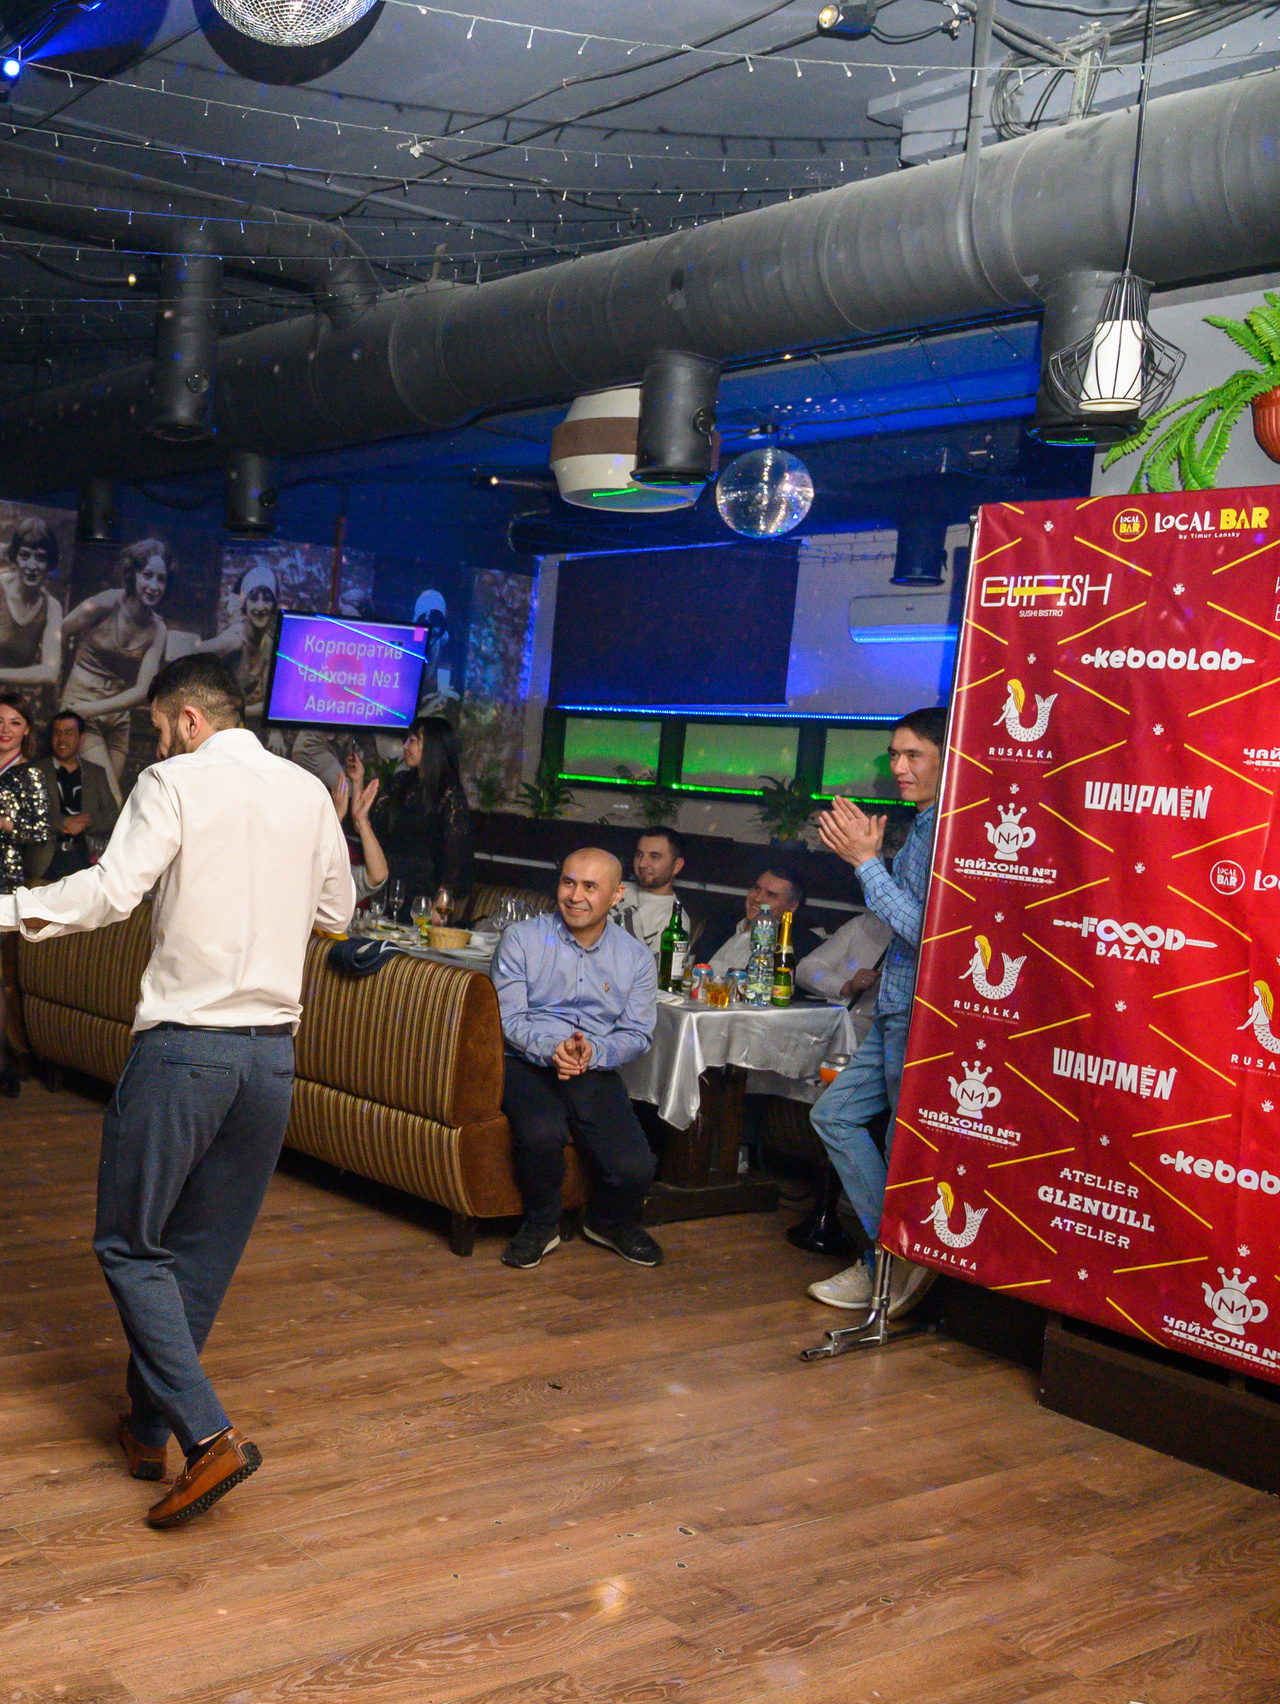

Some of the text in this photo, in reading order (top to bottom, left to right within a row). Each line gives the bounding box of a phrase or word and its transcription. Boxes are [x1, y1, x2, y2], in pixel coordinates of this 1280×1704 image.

[1119, 522, 1141, 533] BAR
[1220, 507, 1269, 530] BAR
[1019, 609, 1063, 618] SUSHI BISTRO
[304, 635, 403, 660] Корпоратив
[298, 664, 400, 689] Чайхона №1
[304, 695, 384, 719] Авиапарк
[988, 747, 1053, 759] RUSALKA
[954, 857, 1057, 879] ЧАЙХОНА №1
[1217, 874, 1238, 887] BAR
[1095, 941, 1161, 965] BAZAR
[953, 999, 1020, 1020] RUSALKA
[1231, 1053, 1277, 1071] RUSA
[918, 1108, 1021, 1142] ЧАЙХОНА №1
[1059, 1167, 1139, 1199] ATELIER
[1174, 1150, 1280, 1195] kebab
[1037, 1185, 1155, 1233] GLENUILL
[1050, 1216, 1131, 1250] ATELIER
[913, 1243, 977, 1271] RUSALKA
[1163, 1315, 1259, 1355] ЧАЙХОНА
